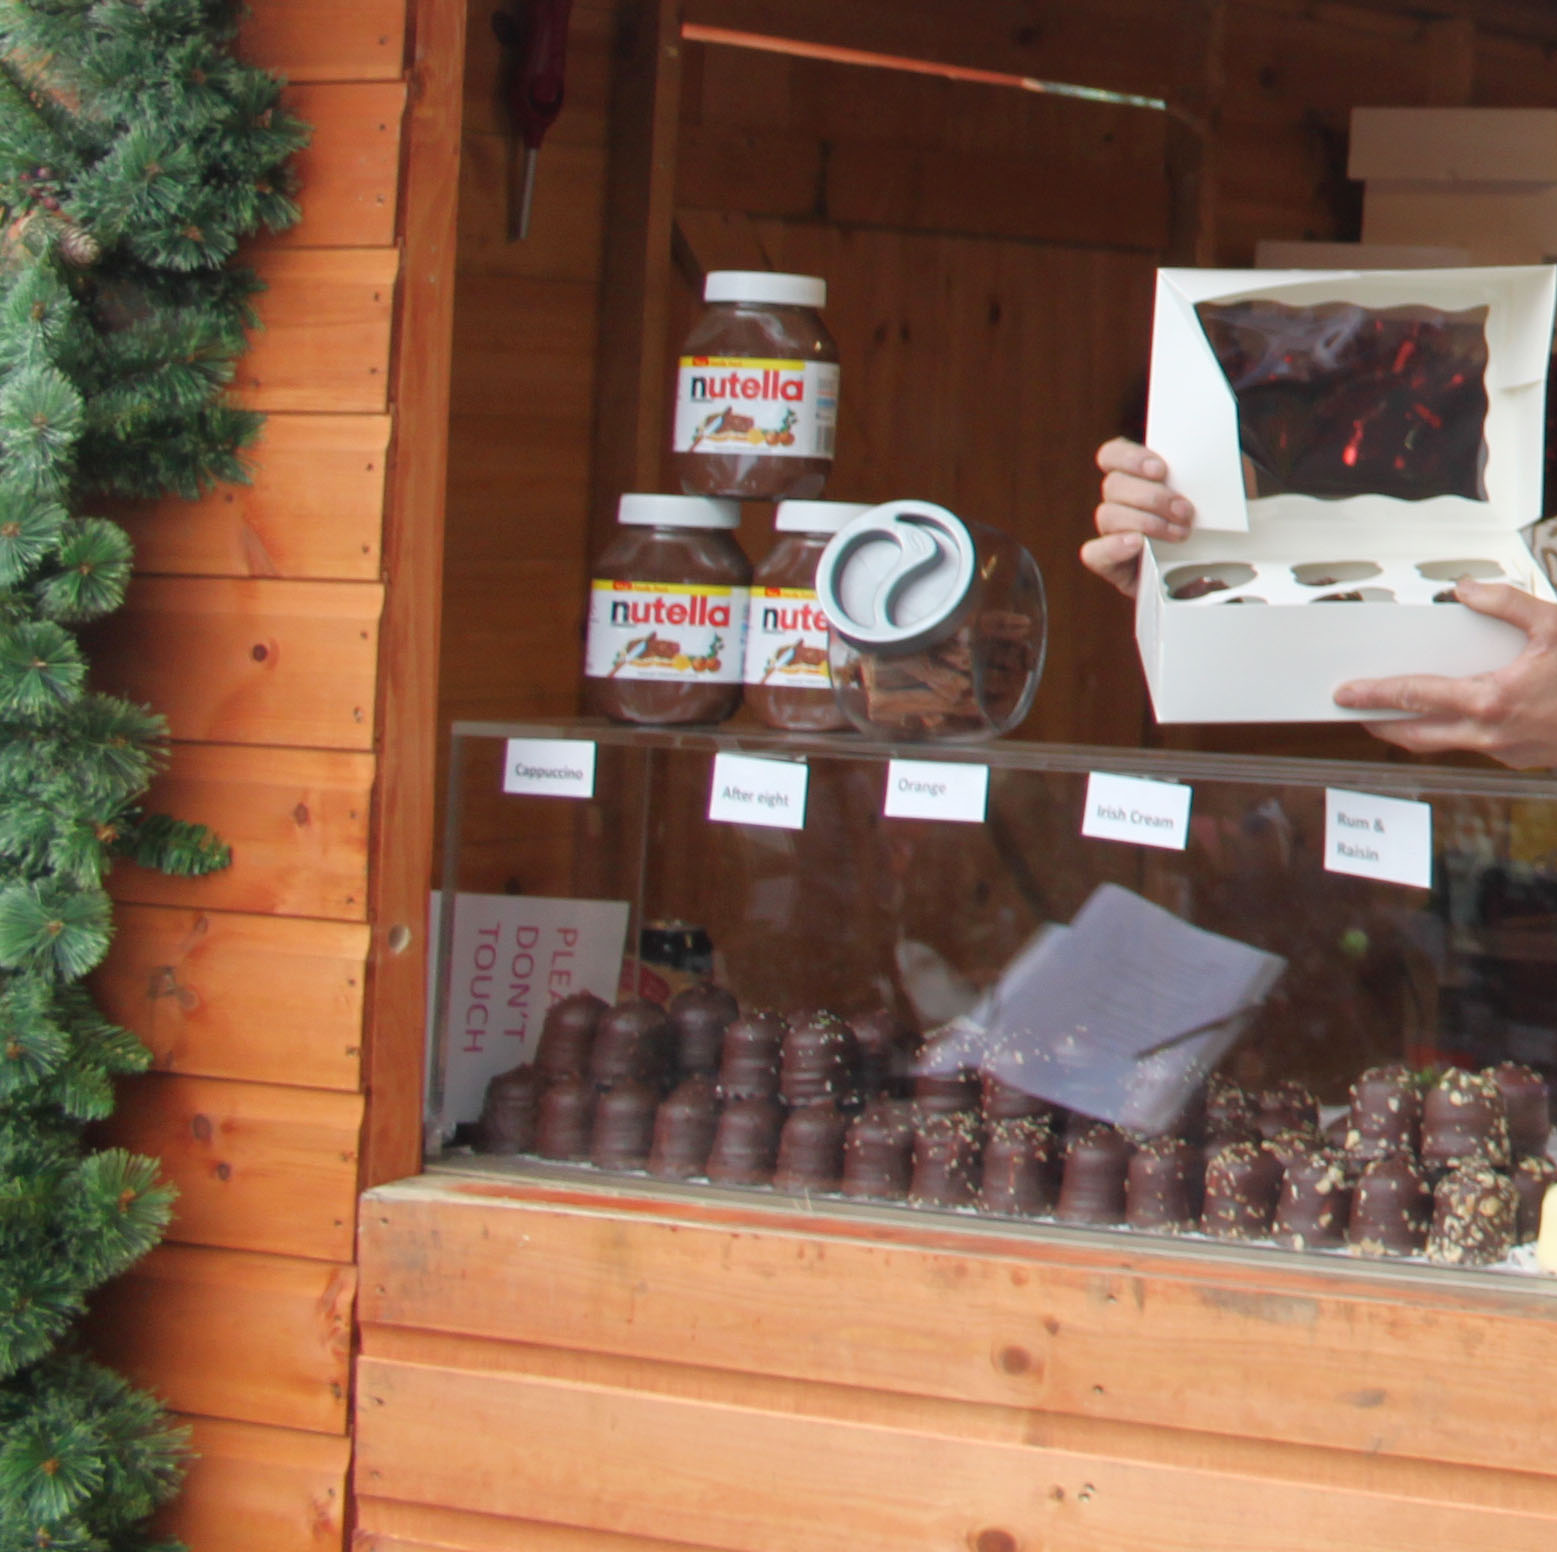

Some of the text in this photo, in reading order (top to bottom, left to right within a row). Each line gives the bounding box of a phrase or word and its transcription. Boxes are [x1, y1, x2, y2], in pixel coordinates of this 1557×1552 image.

[691, 368, 804, 401] nutella
[611, 595, 731, 627] nutella
[763, 603, 829, 632] nute
[515, 763, 584, 781] Cappuccino
[722, 786, 790, 808] After eight
[898, 778, 946, 797] Orange
[1096, 804, 1174, 829] Irish Cream
[1337, 811, 1385, 833] Rum &
[1336, 840, 1379, 862] Raisin
[547, 926, 580, 1000] PLE
[463, 920, 501, 1054] TOUCH
[503, 925, 540, 1044] DON'T
